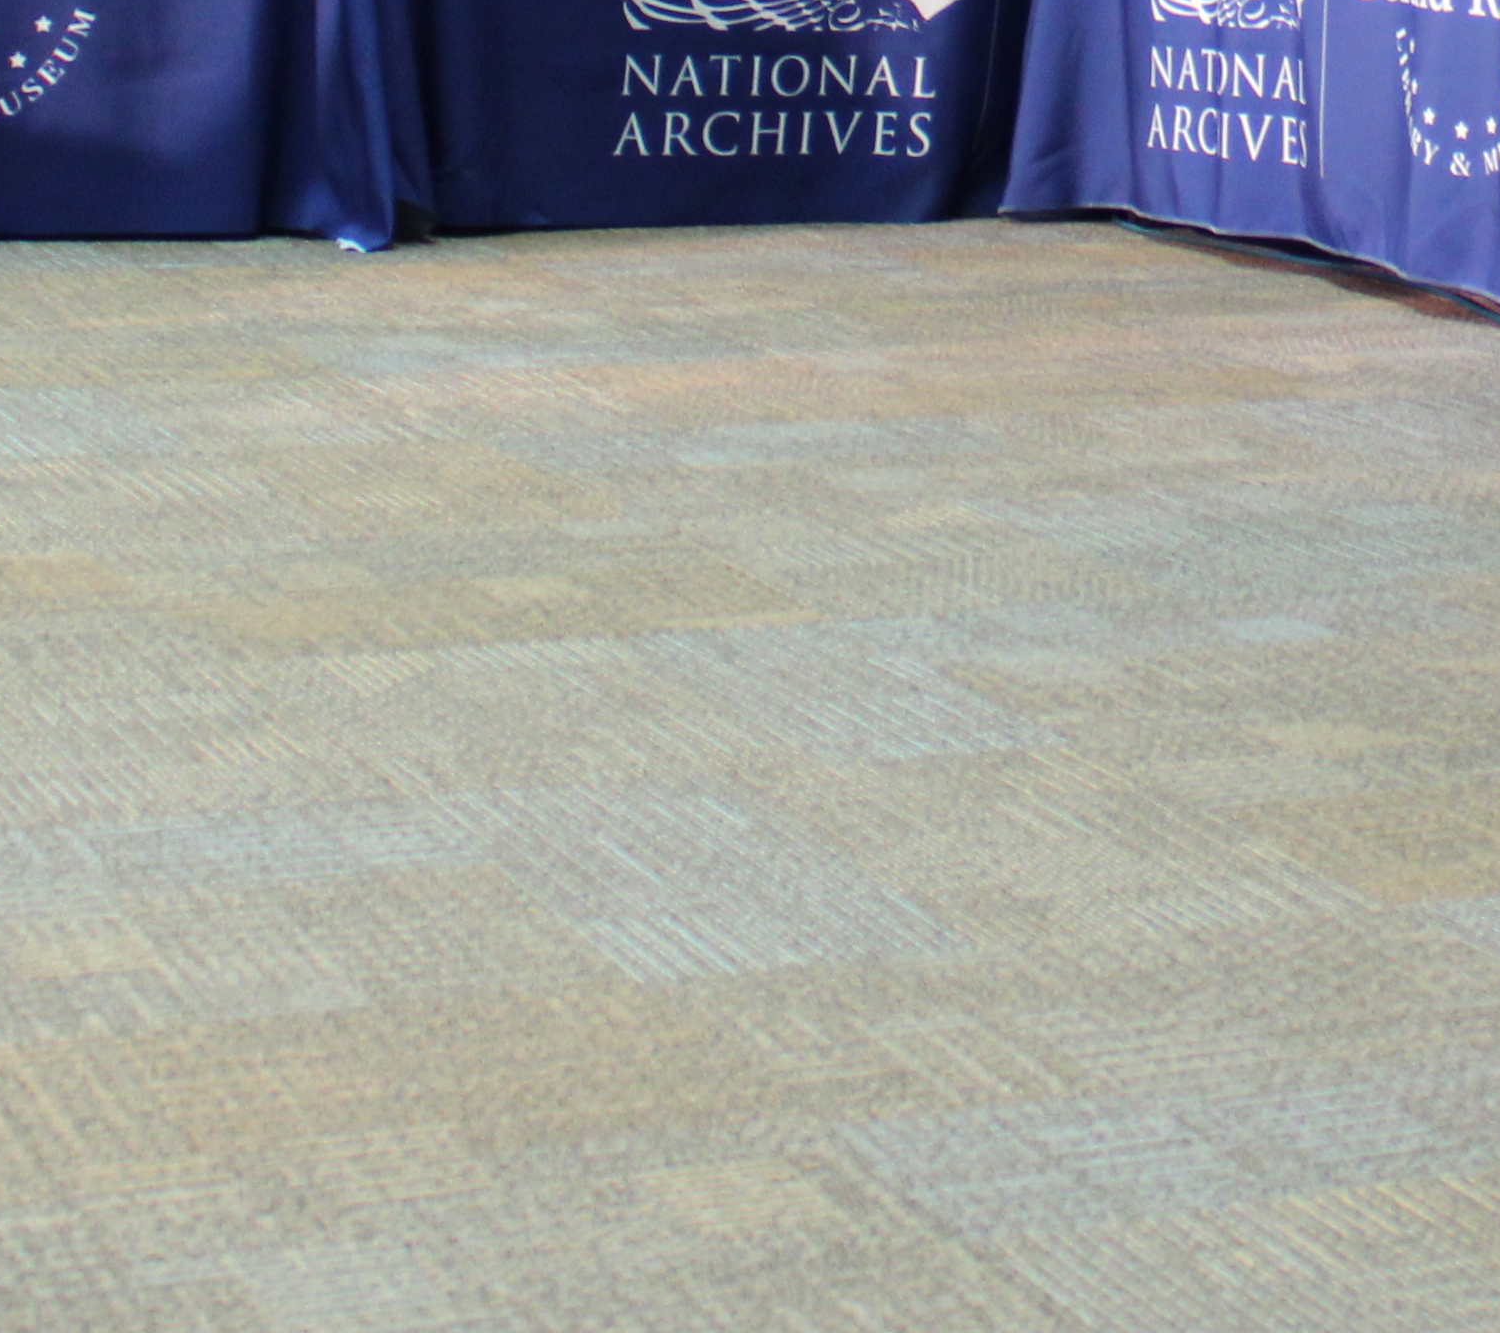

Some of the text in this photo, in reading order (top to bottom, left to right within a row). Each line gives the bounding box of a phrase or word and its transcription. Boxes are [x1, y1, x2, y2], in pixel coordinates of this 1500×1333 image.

[623, 54, 936, 99] NATIONAL
[614, 111, 932, 157] ARCHIVES
[1450, 150, 1471, 178] &
